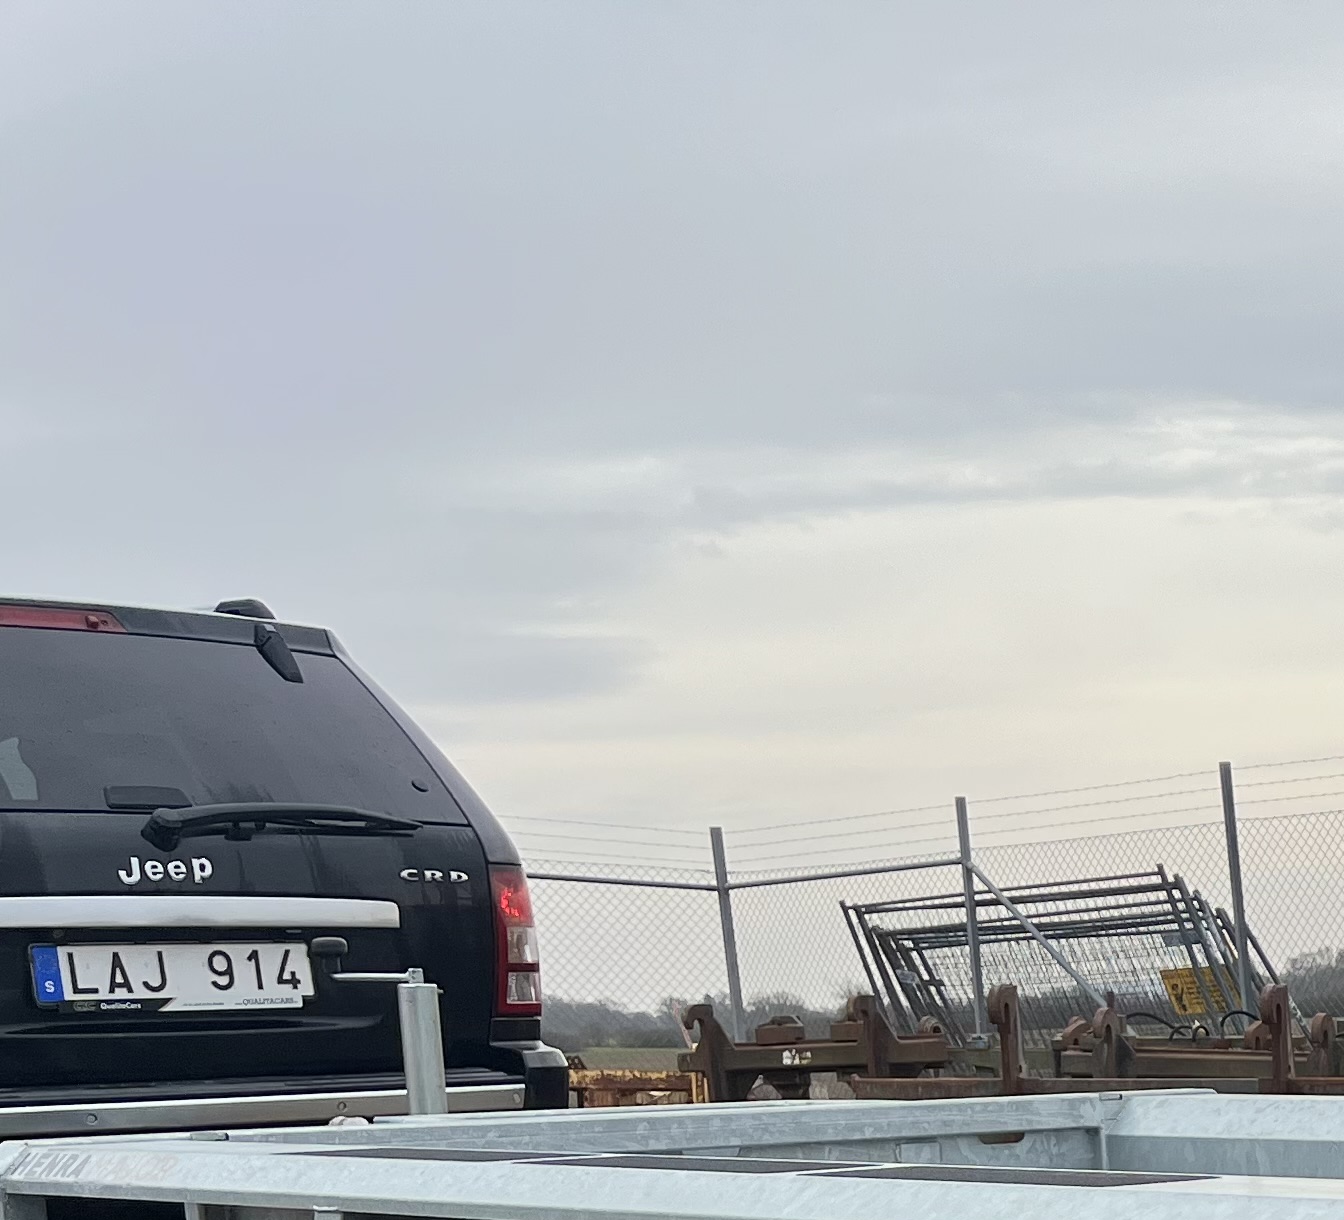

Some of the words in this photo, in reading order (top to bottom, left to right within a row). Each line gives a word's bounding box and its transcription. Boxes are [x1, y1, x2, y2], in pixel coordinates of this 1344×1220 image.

[117, 855, 213, 885] Jeep
[399, 868, 470, 883] CRD
[66, 950, 167, 994] LAJ
[207, 949, 301, 991] 914
[45, 980, 55, 993] S
